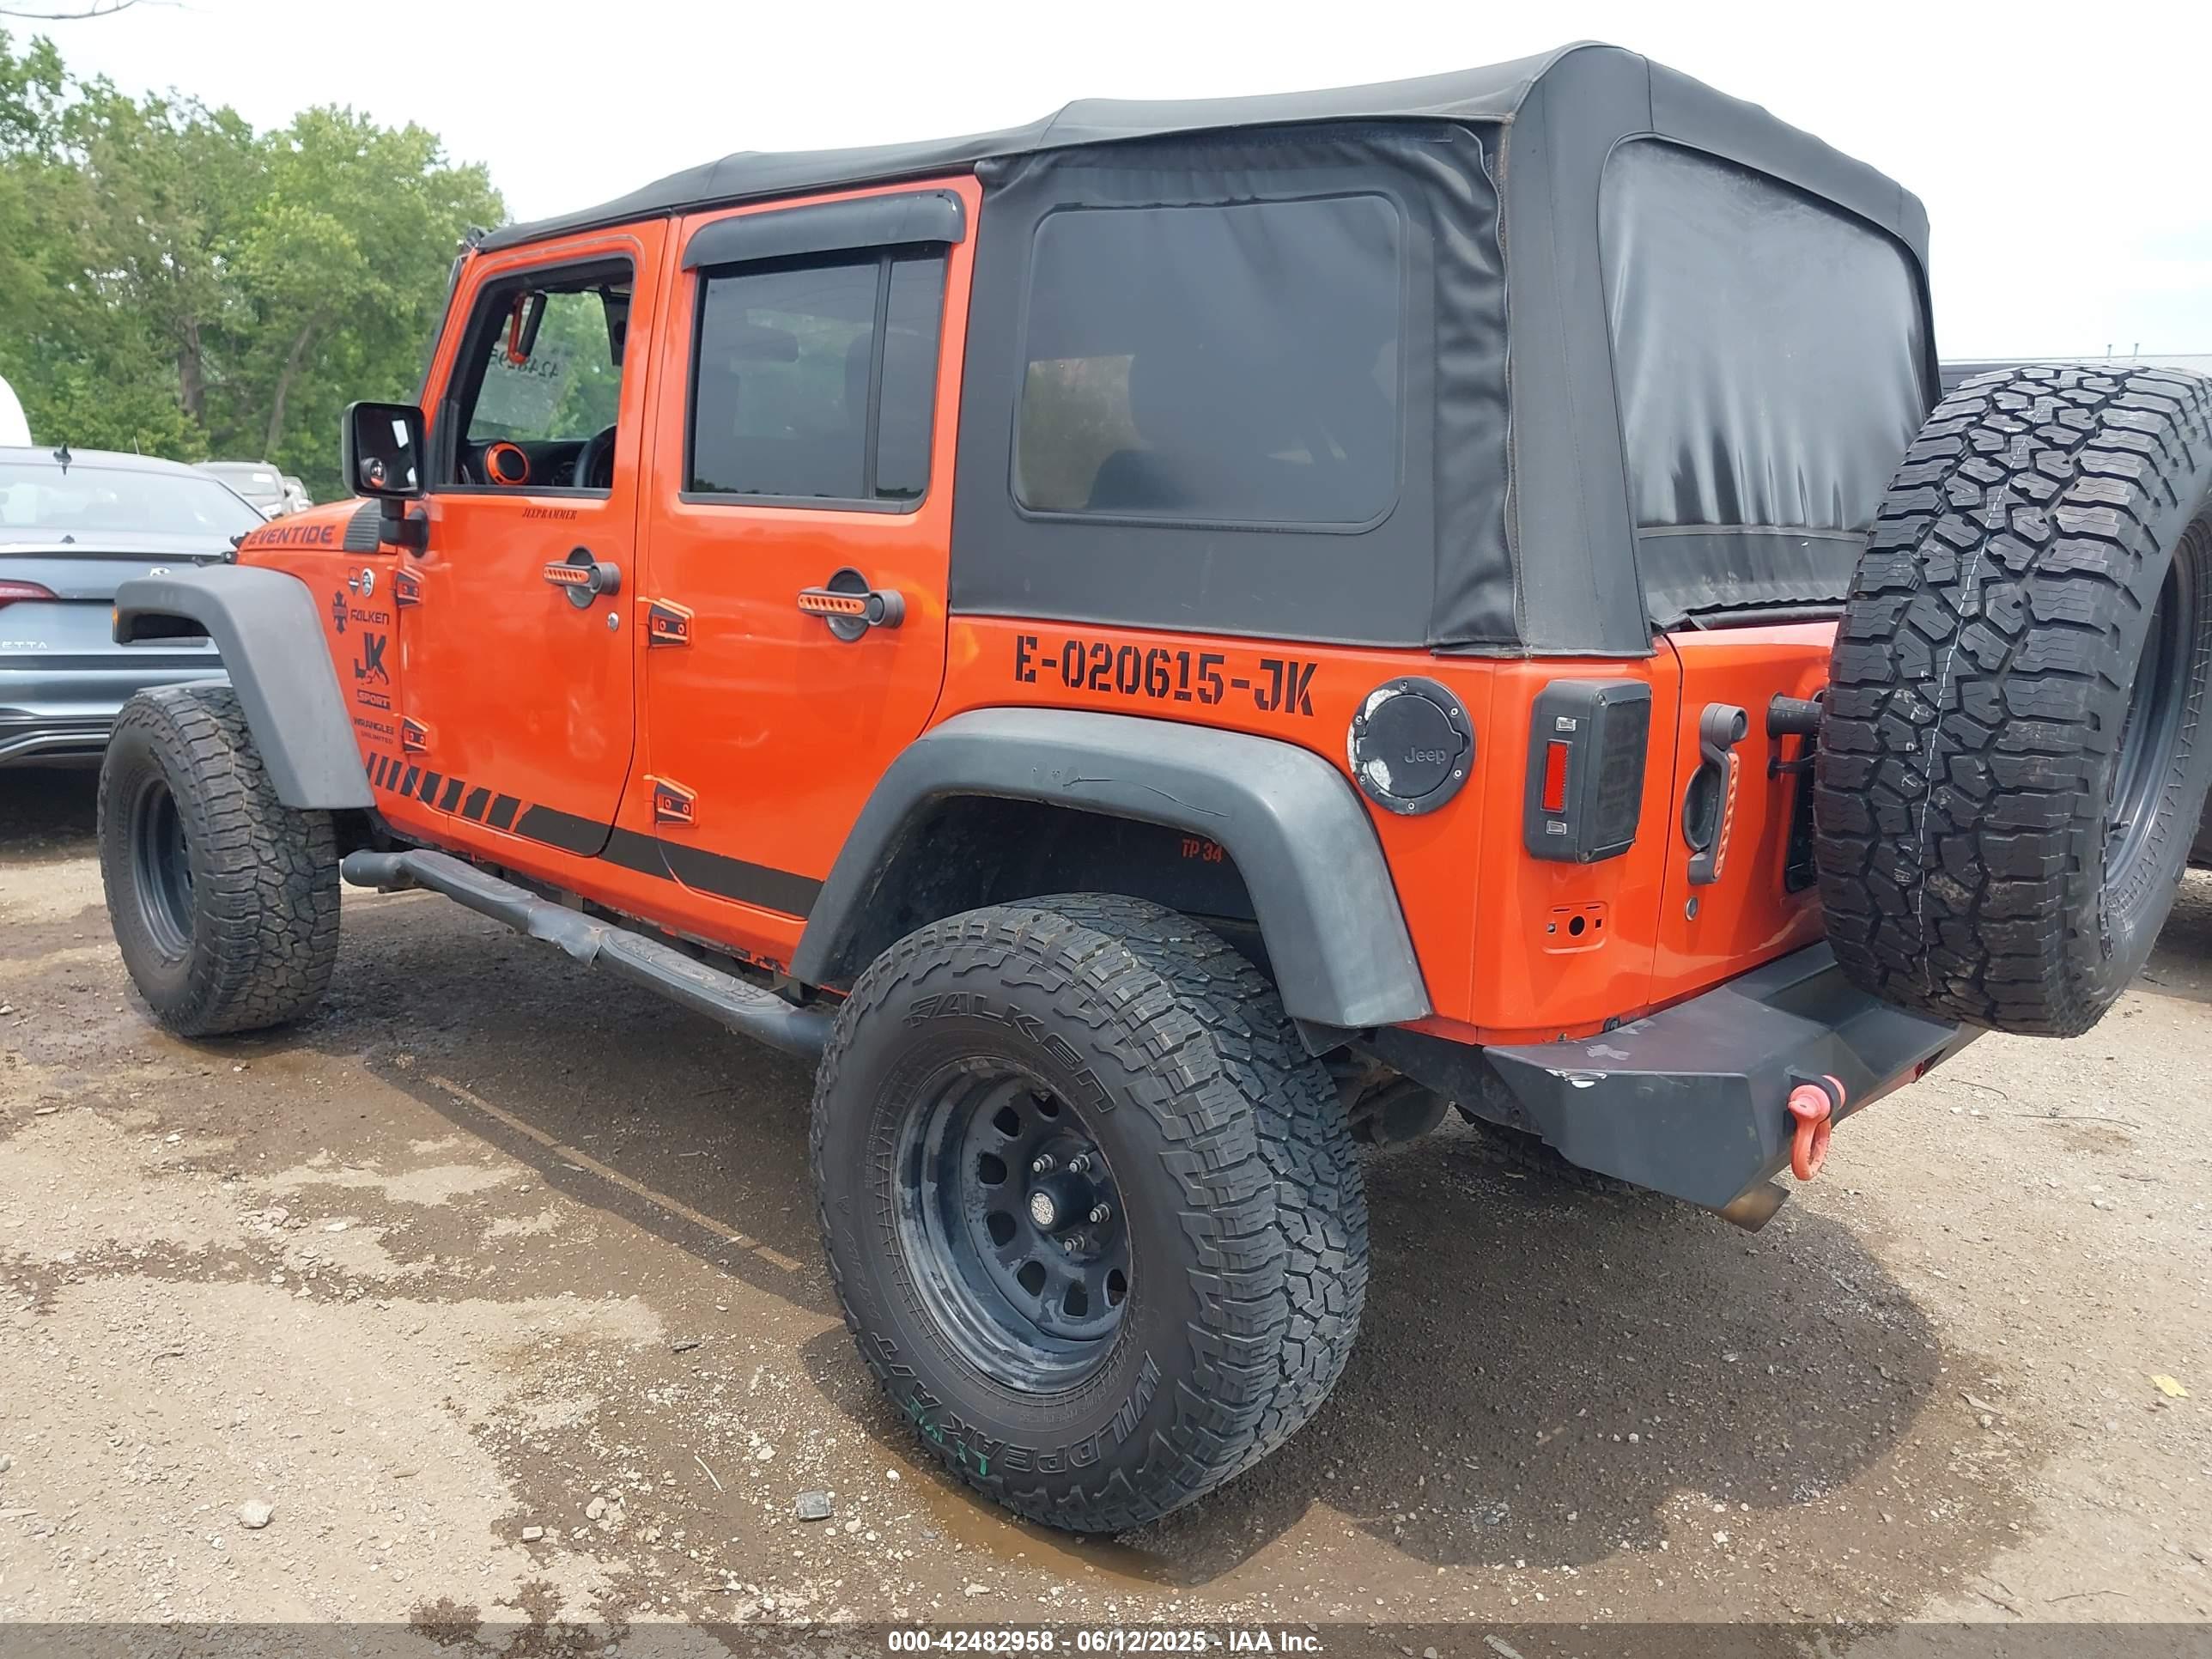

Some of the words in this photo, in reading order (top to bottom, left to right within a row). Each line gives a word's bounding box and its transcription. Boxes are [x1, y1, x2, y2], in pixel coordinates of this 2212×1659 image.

[248, 525, 337, 544] EVENTIDE
[350, 609, 390, 625] FALKEN
[1, 641, 48, 650] ETTA
[354, 632, 389, 684] JK
[1015, 635, 1318, 717] E-020615-JK
[1405, 747, 1447, 764] Jeep
[902, 991, 1116, 1114] FALKEN
[940, 1350, 1162, 1474] WILDPEAK
